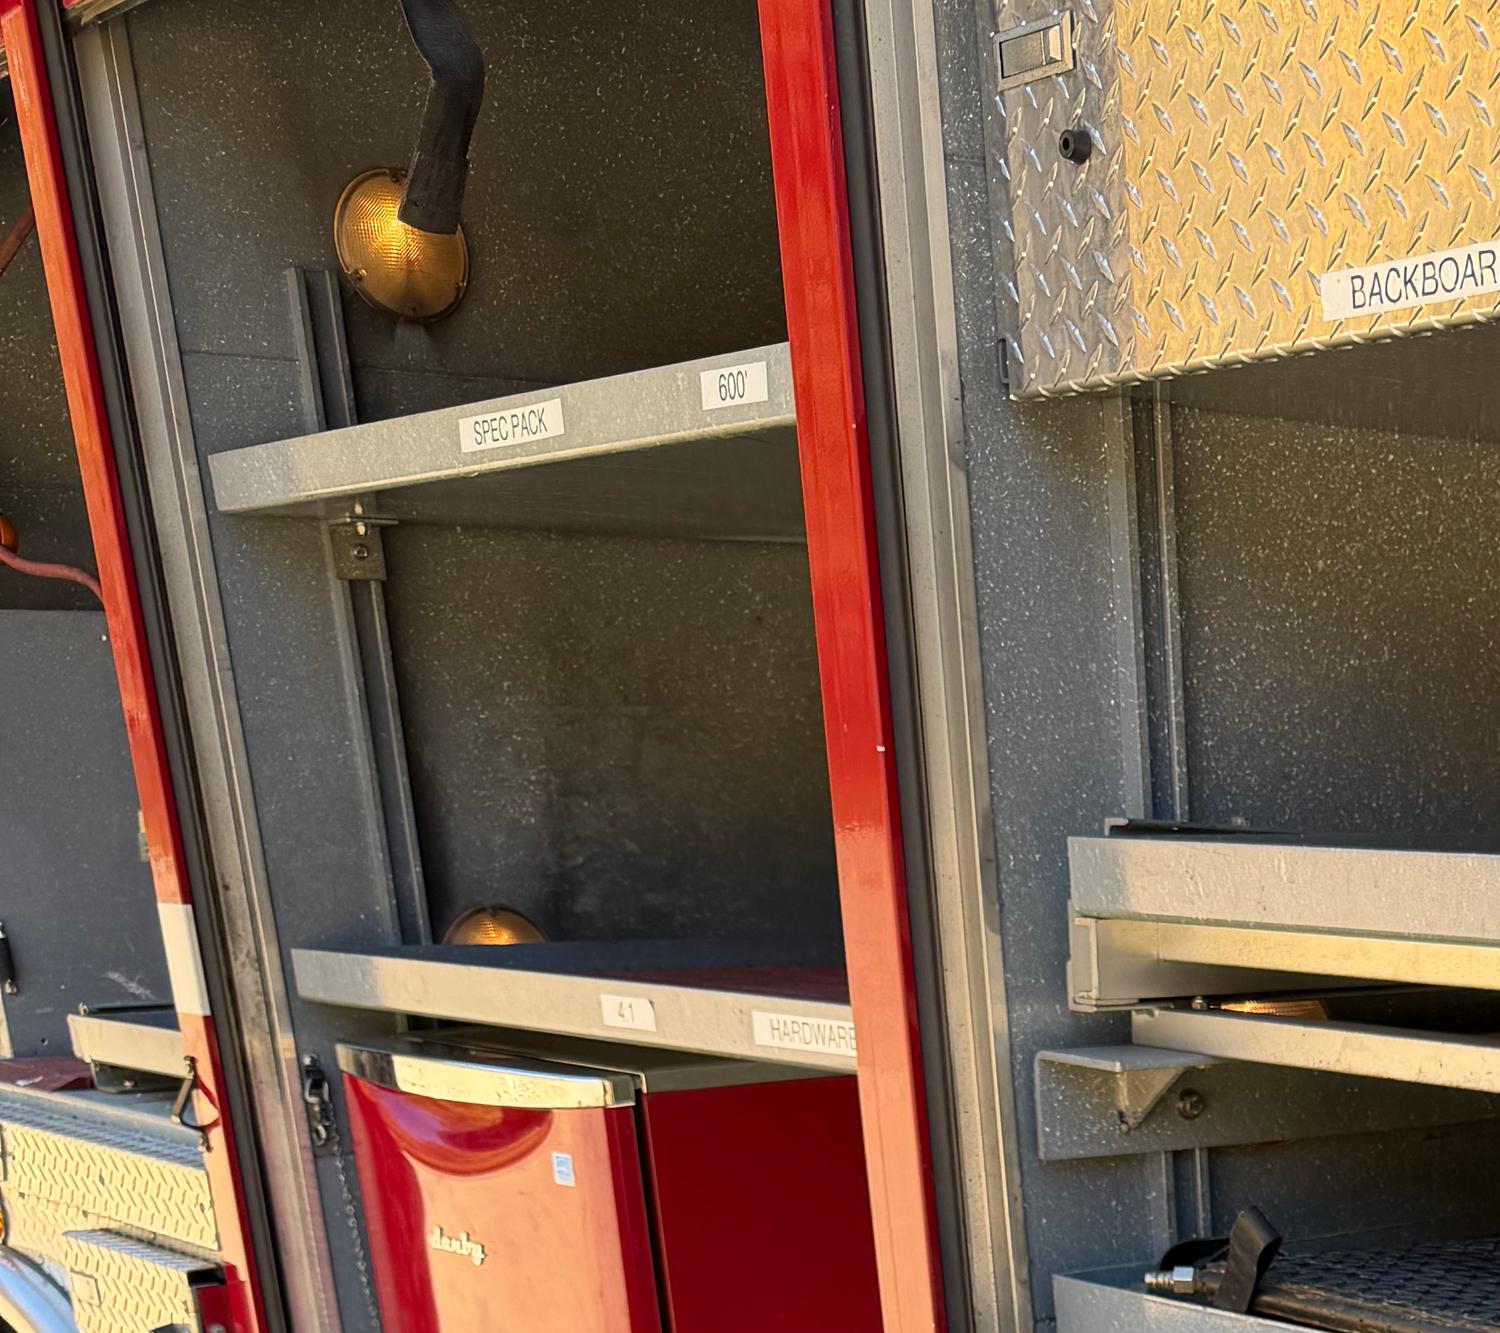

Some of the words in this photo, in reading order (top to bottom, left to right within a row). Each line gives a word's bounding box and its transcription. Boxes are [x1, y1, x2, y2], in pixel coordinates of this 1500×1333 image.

[717, 370, 749, 402] 600'
[472, 413, 510, 446] SPEC
[511, 406, 549, 439] PACK
[429, 1224, 487, 1267] danby
